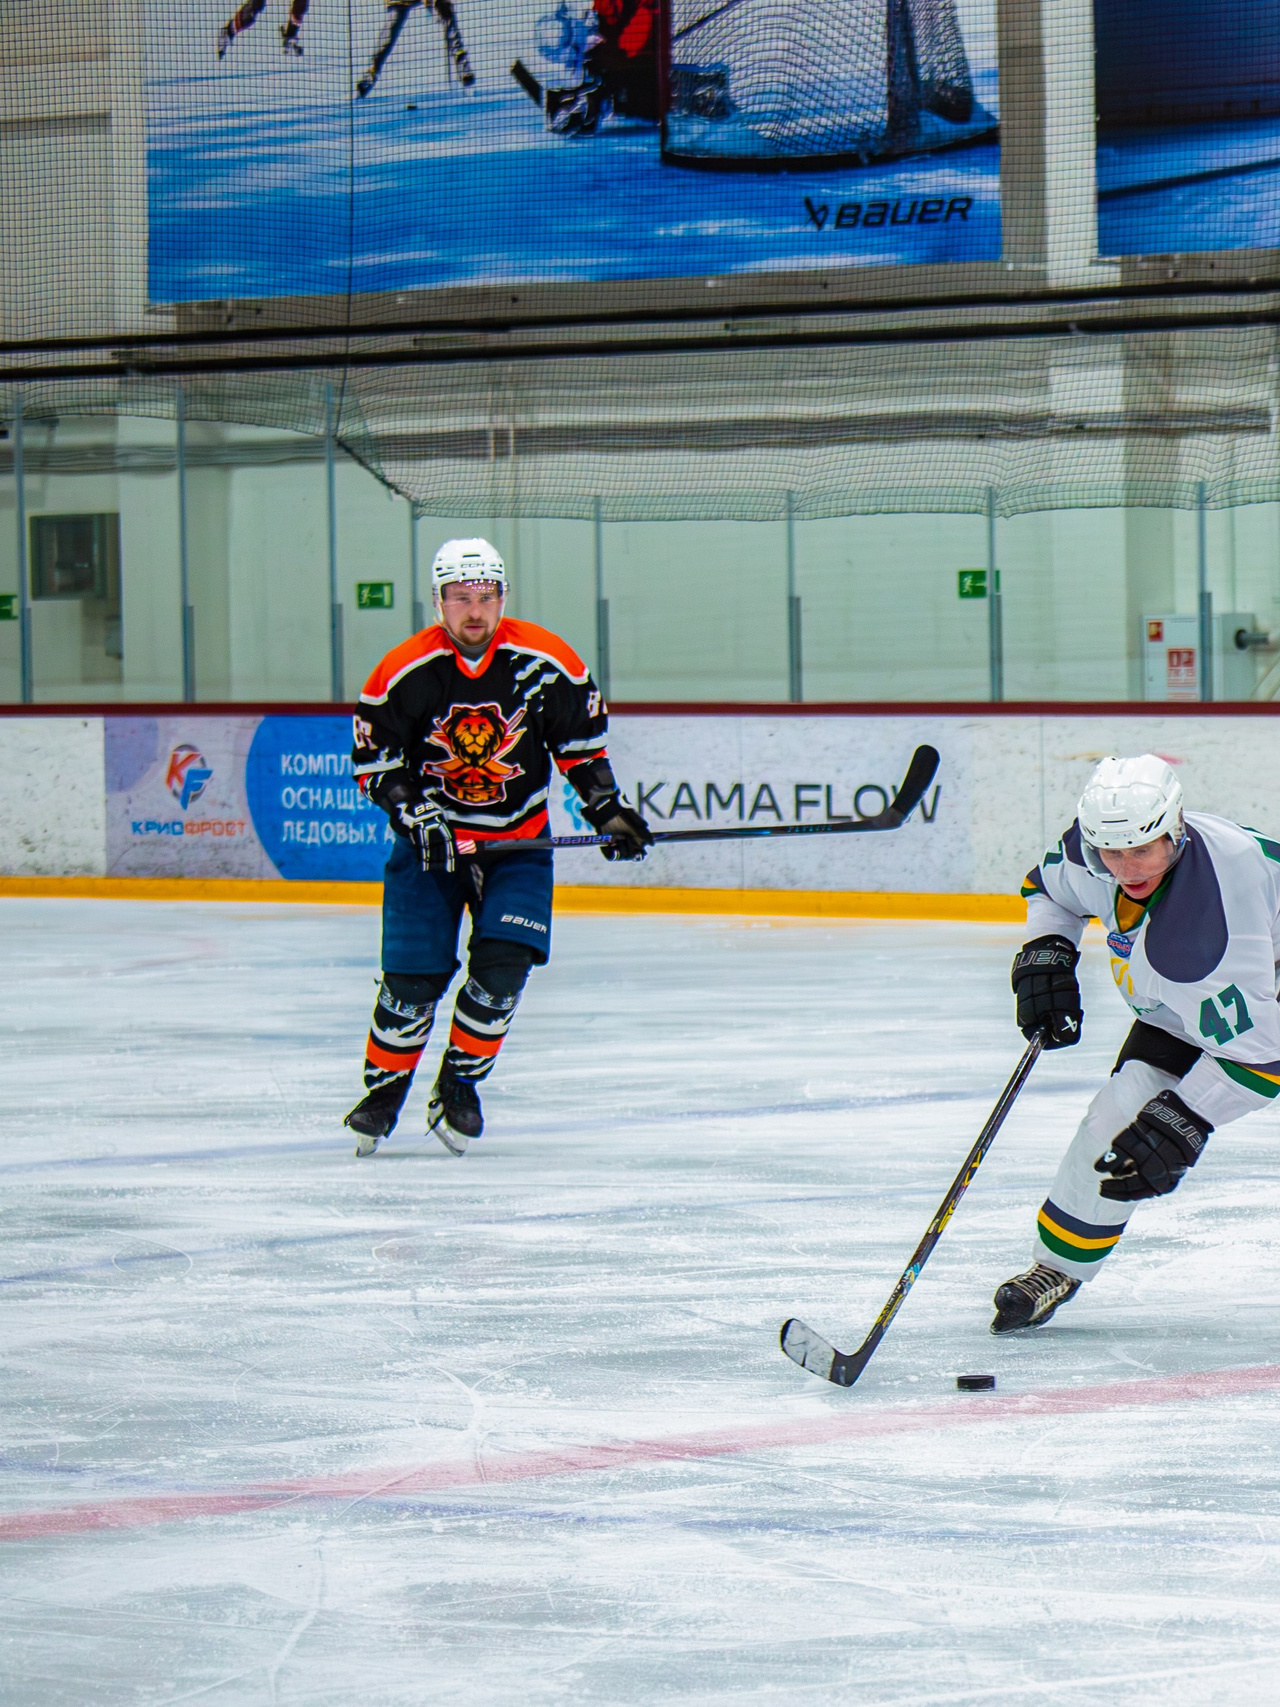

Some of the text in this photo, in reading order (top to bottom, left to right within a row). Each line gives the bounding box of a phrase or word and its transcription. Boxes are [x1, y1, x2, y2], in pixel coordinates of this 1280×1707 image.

[834, 197, 972, 230] BAUER
[637, 781, 783, 821] KAMA
[131, 821, 246, 836] КРИОФРОСТ
[282, 820, 377, 848] ЛЕДОВЫХ
[501, 914, 547, 934] BAUER
[1199, 983, 1254, 1046] 47
